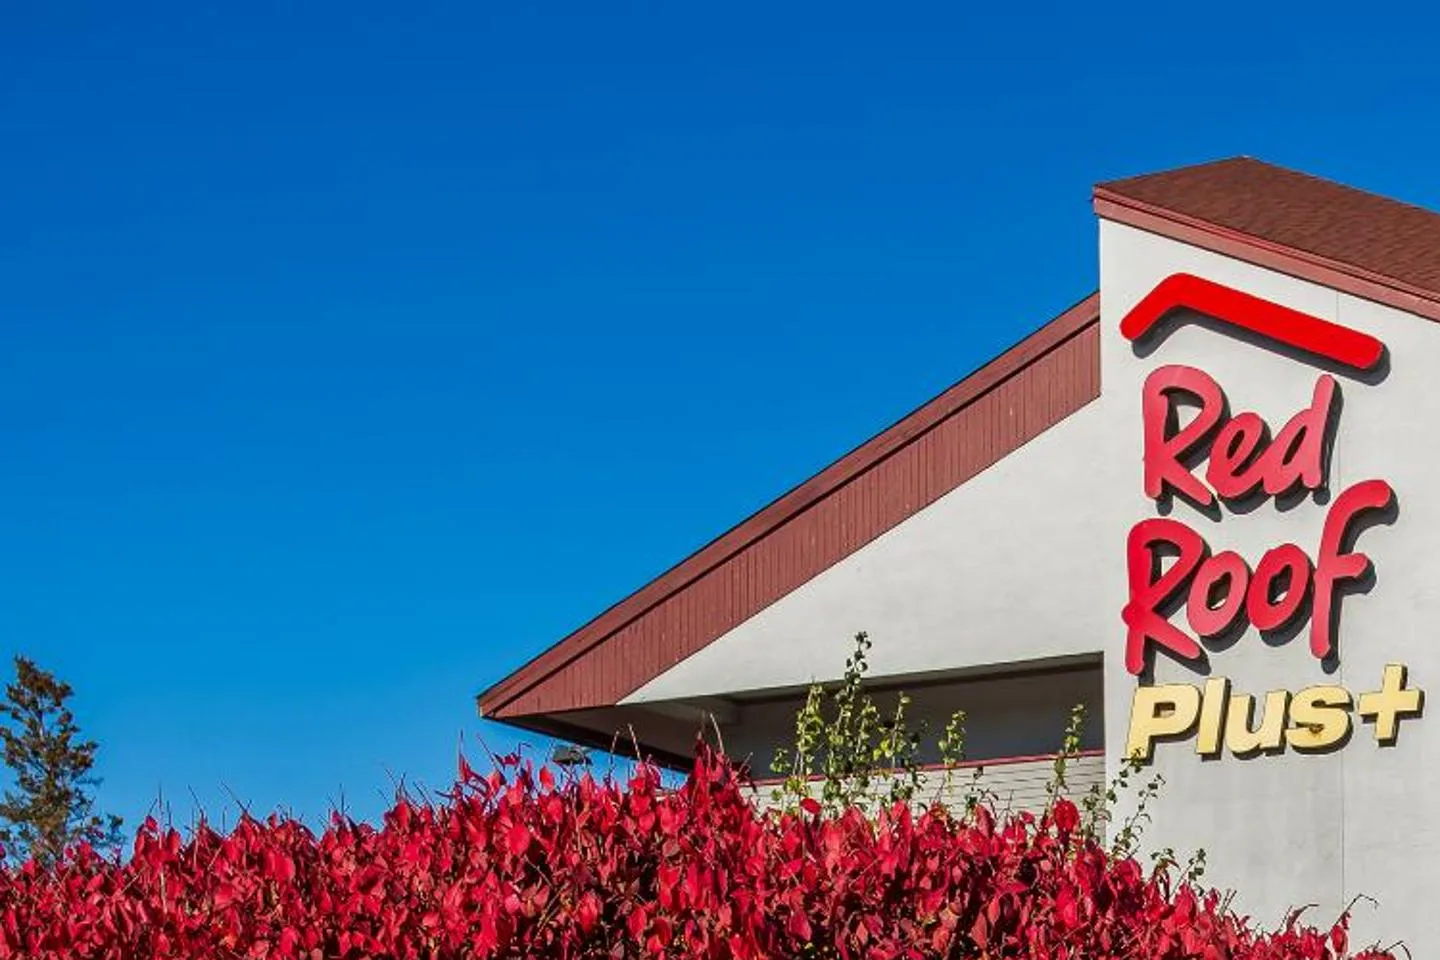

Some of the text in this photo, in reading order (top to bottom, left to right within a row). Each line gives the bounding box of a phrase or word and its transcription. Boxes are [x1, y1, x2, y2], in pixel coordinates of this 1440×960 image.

[1142, 365, 1336, 506] Red
[1121, 479, 1392, 676] Roof
[1126, 663, 1422, 759] Plus+
